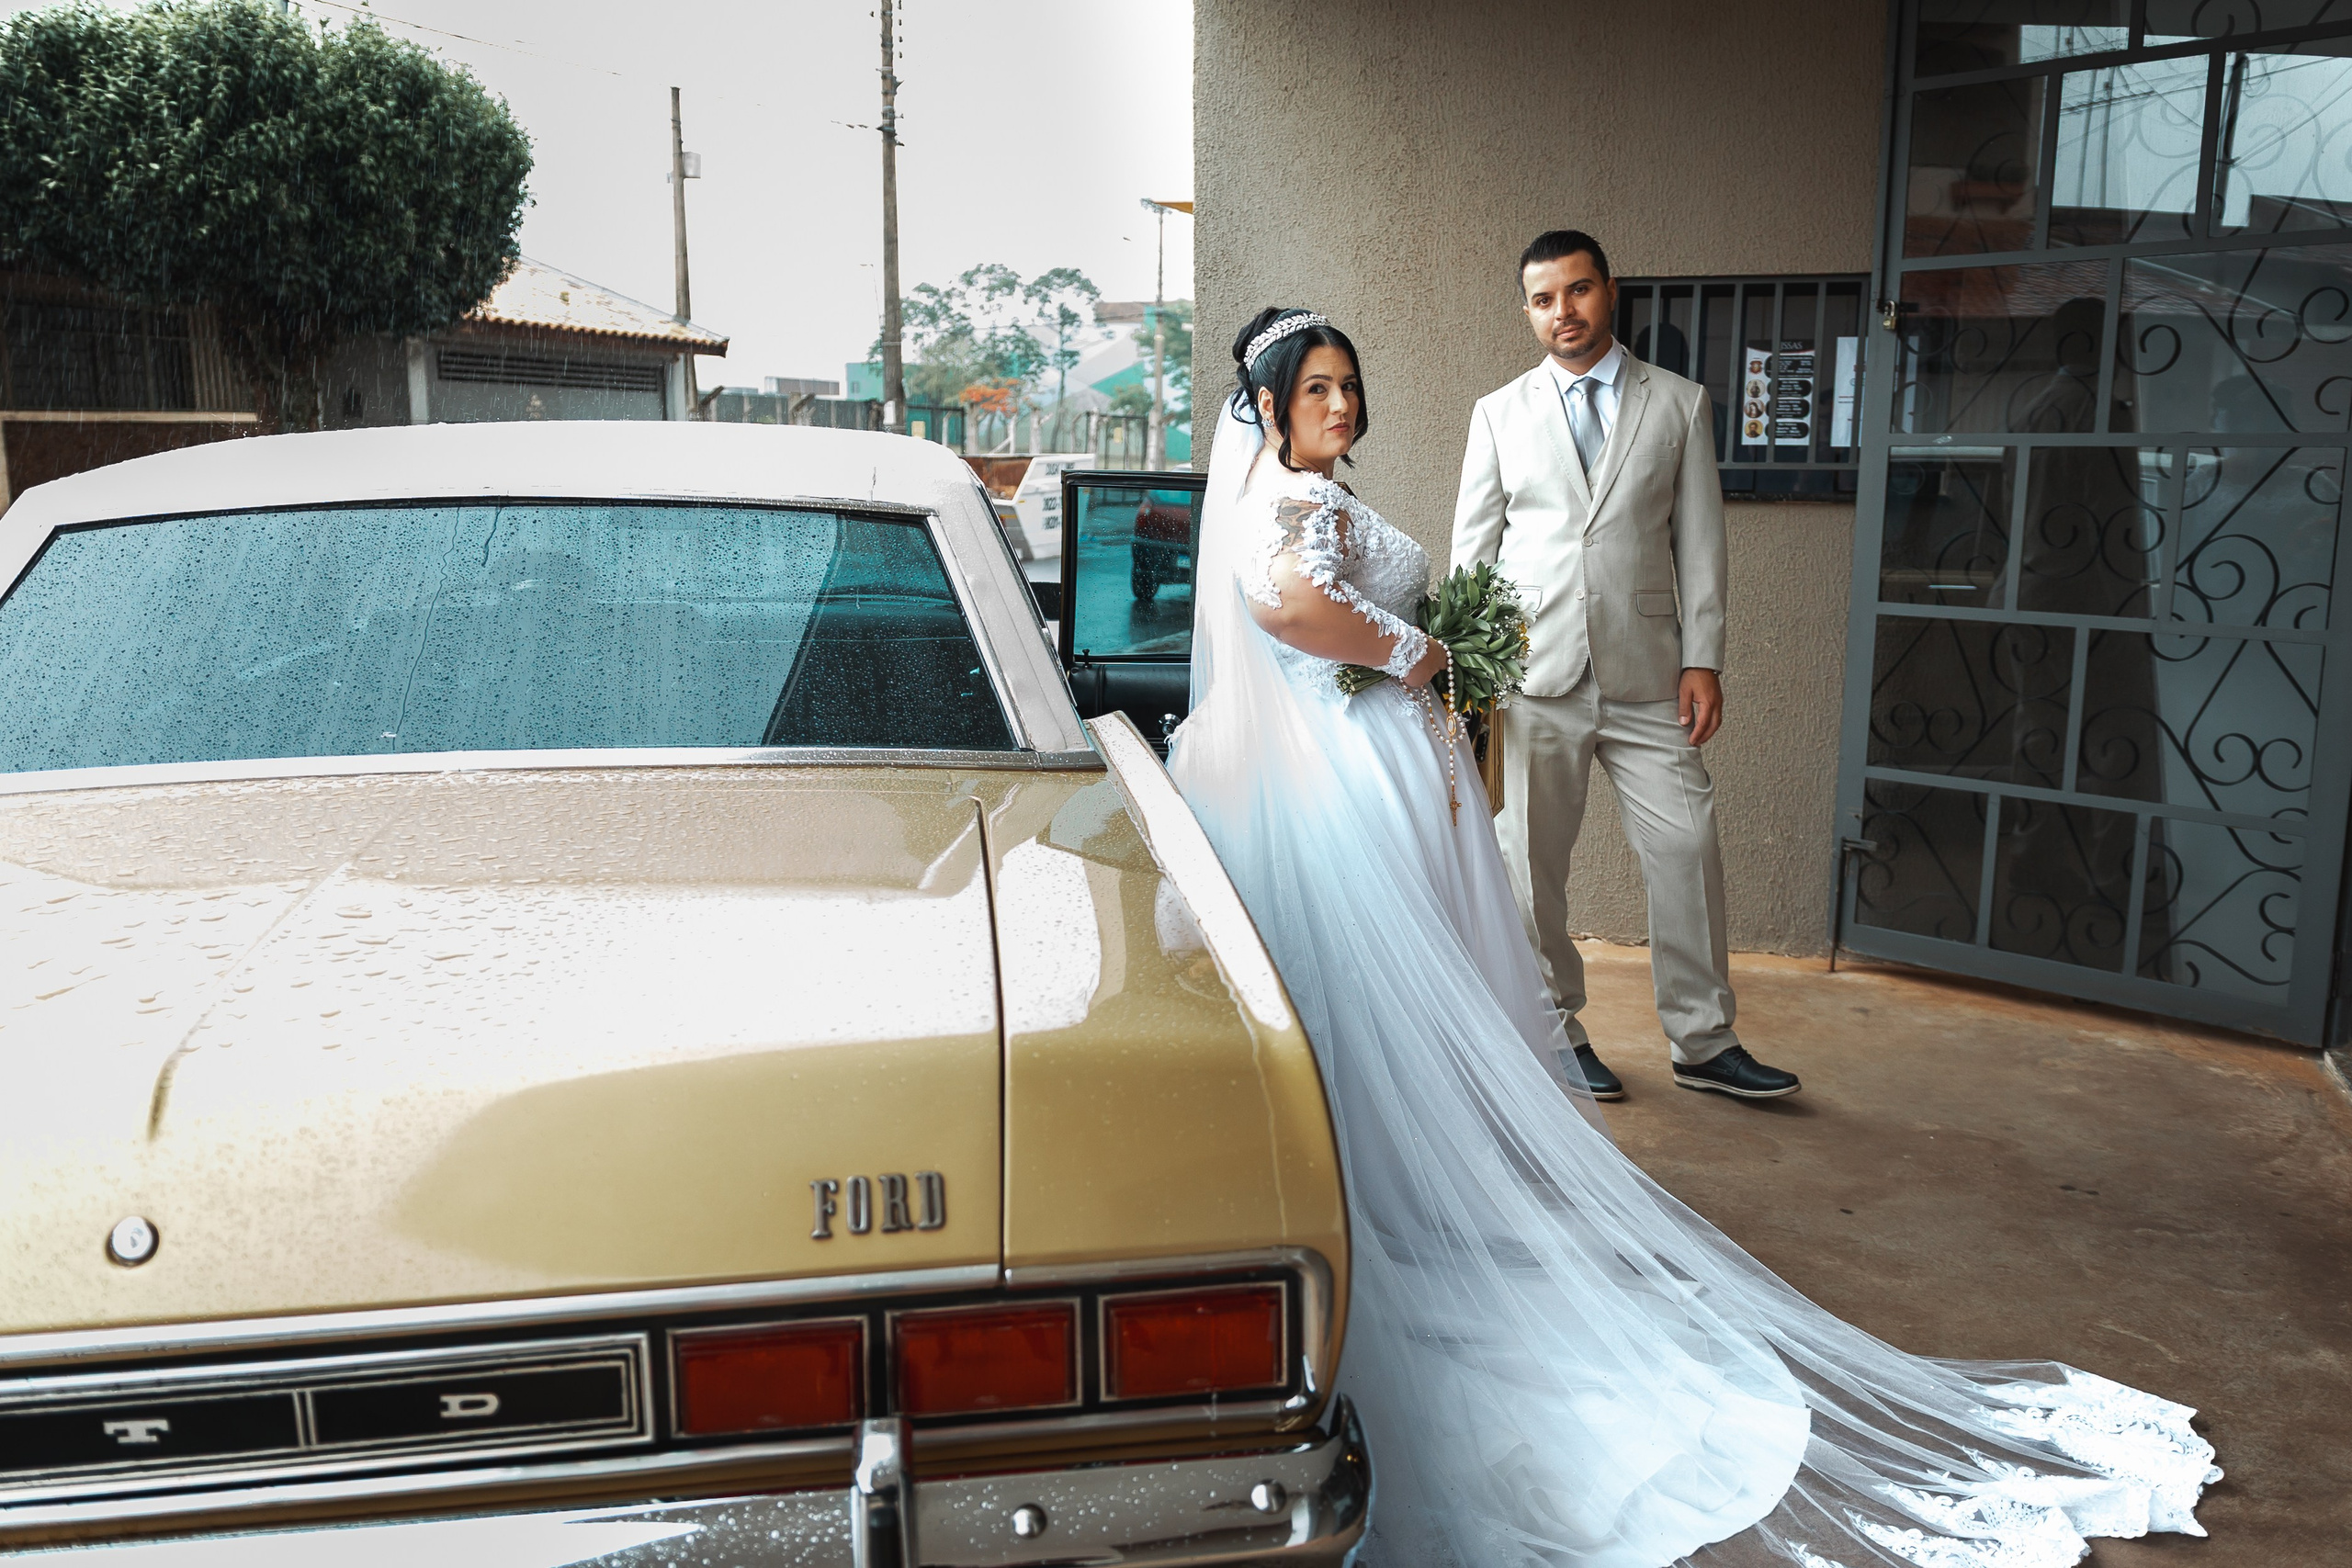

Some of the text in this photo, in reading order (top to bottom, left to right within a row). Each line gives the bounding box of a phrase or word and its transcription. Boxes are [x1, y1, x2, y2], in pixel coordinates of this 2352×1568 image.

[1780, 341, 1804, 350] ISSAS
[809, 1170, 946, 1239] FORD
[103, 1393, 500, 1445] T D
